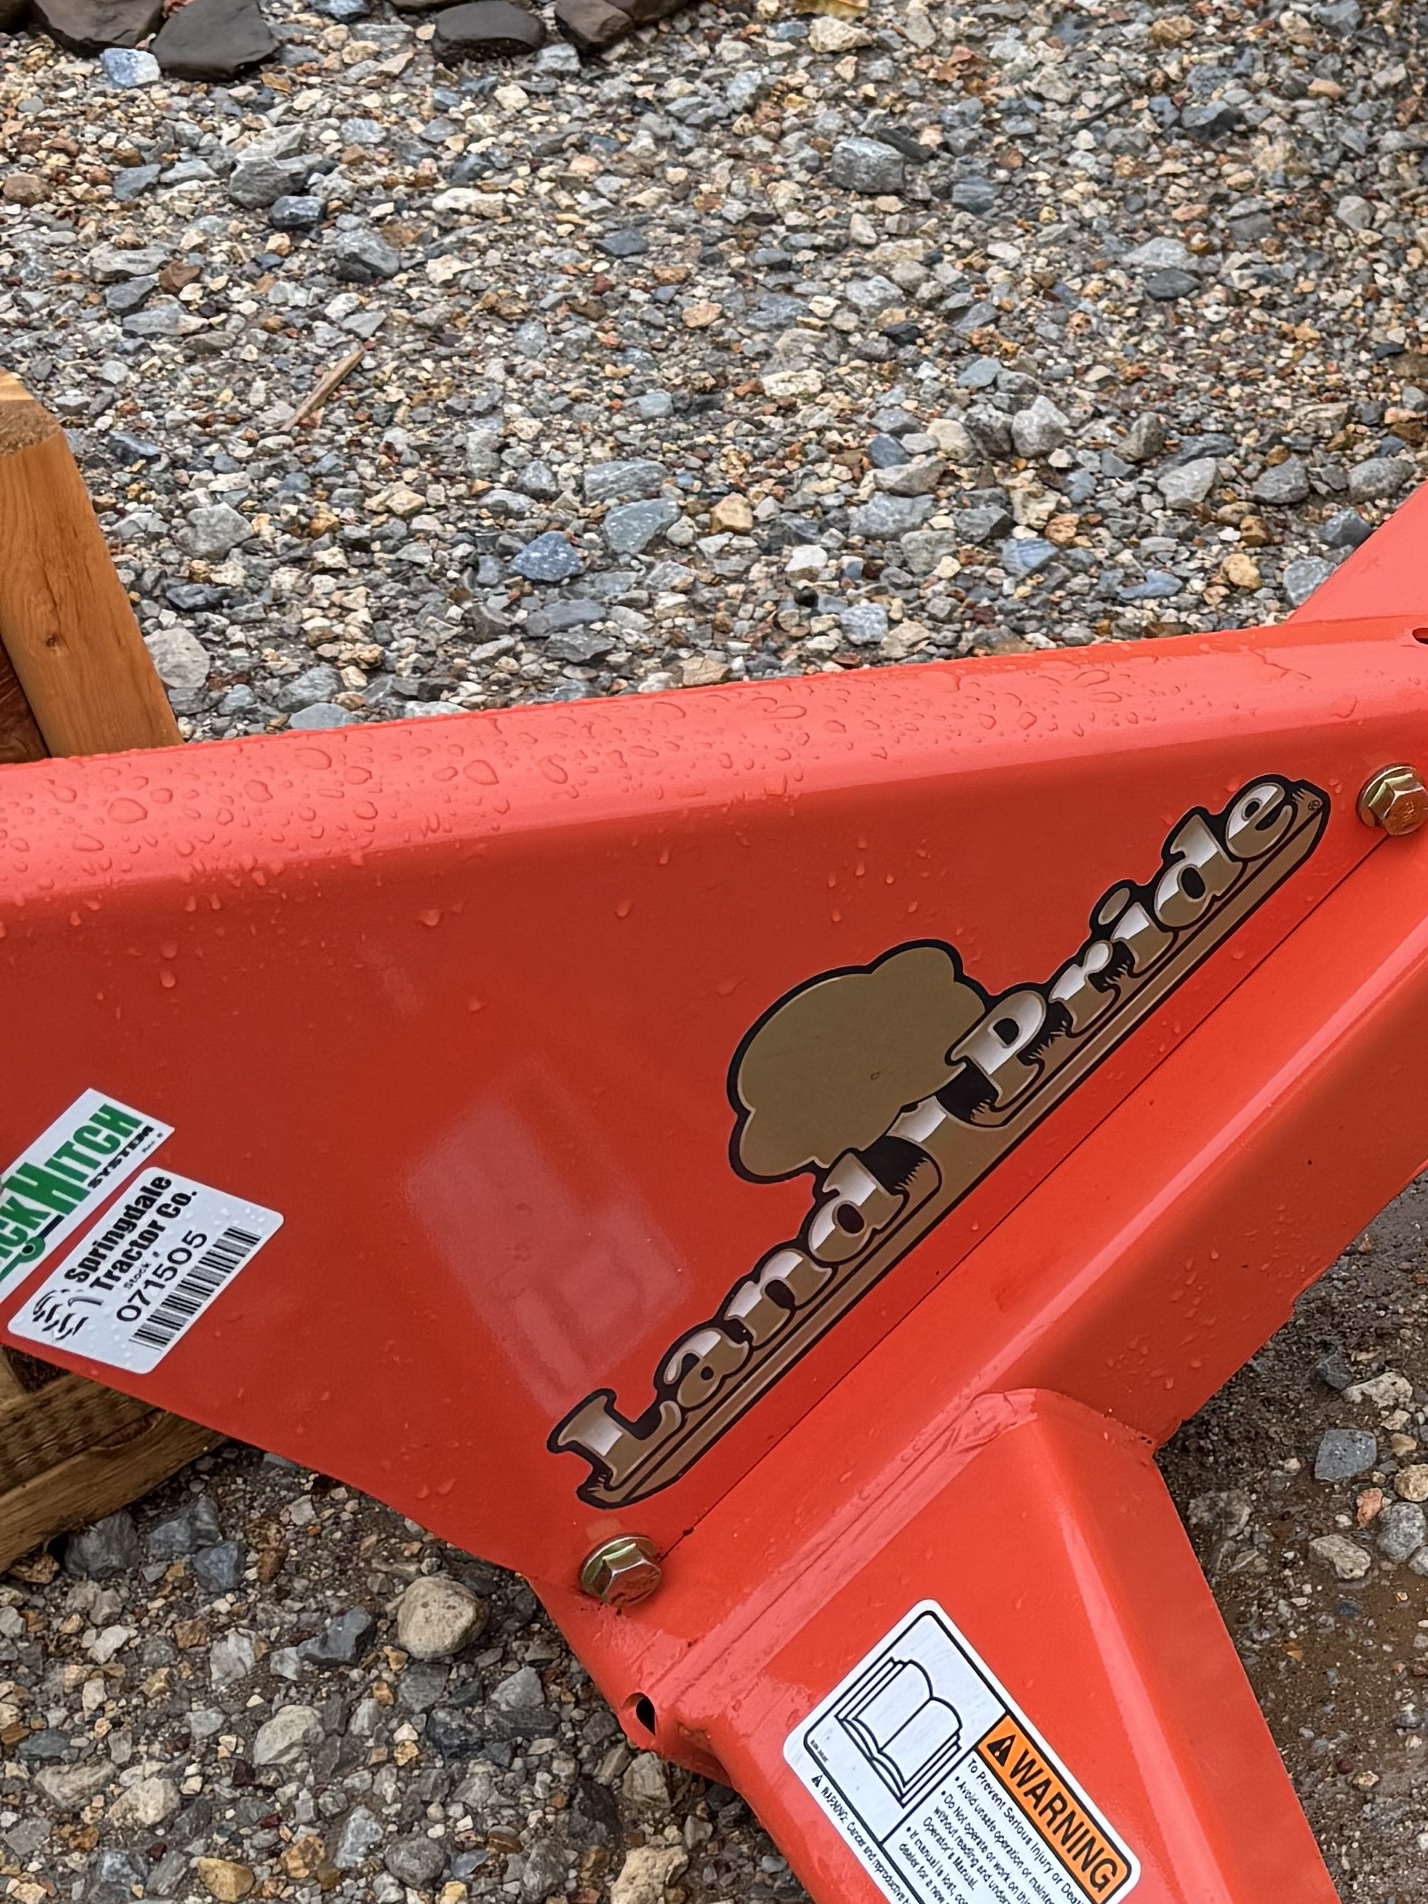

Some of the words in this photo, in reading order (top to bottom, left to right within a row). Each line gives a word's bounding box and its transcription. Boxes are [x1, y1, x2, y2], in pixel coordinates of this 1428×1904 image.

[558, 1151, 908, 1488] Land
[947, 778, 1300, 1111] Pride
[87, 1125, 155, 1189] SYSTEM
[61, 1172, 176, 1286] Springdale
[87, 1217, 169, 1295] Tractor
[152, 1183, 198, 1221] Co.
[112, 1227, 210, 1325] 071505
[122, 1261, 153, 1290] Stock
[942, 1792, 958, 1810] Do
[952, 1805, 969, 1825] Not
[955, 1778, 979, 1807] Avoid
[972, 1801, 999, 1833] unsafe
[989, 1827, 1026, 1872] operation
[1020, 1865, 1032, 1879] or
[960, 1820, 990, 1856] operate
[965, 1757, 981, 1775] To
[974, 1770, 1008, 1811] Prevent
[1002, 1805, 1035, 1846] Serious
[1027, 1841, 1056, 1877] Injury
[1050, 1870, 1063, 1886] or
[1004, 1748, 1122, 1895] WARNING
[913, 1835, 940, 1869] manual
[931, 1803, 960, 1838] without
[951, 1832, 981, 1869] reading
[975, 1862, 992, 1883] and
[984, 1850, 996, 1864] or
[934, 1863, 946, 1878] is
[939, 1872, 959, 1897] lost,
[991, 1859, 1012, 1884] work
[1006, 1879, 1020, 1895] on
